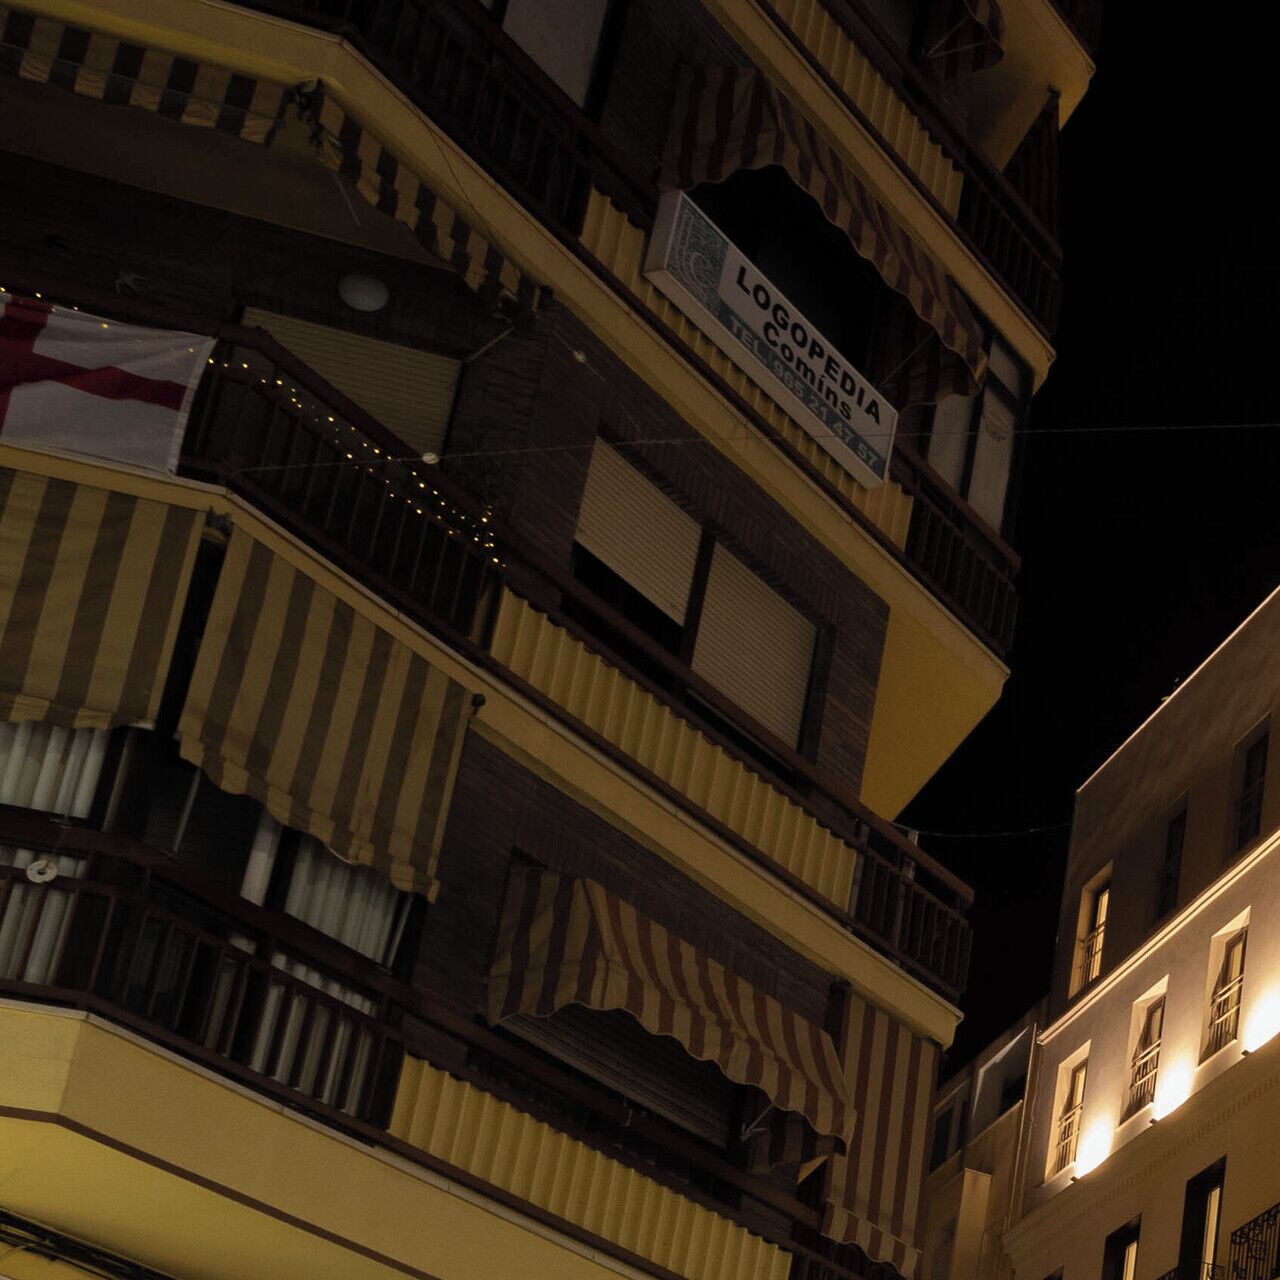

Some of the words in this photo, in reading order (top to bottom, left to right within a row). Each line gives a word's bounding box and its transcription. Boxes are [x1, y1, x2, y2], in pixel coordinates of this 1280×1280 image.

[736, 266, 882, 426] LOGOPEDIA
[763, 321, 852, 421] Comíns
[774, 358, 806, 395] 965
[807, 395, 828, 422] 21
[832, 419, 853, 446] 47
[857, 441, 878, 466] 57
